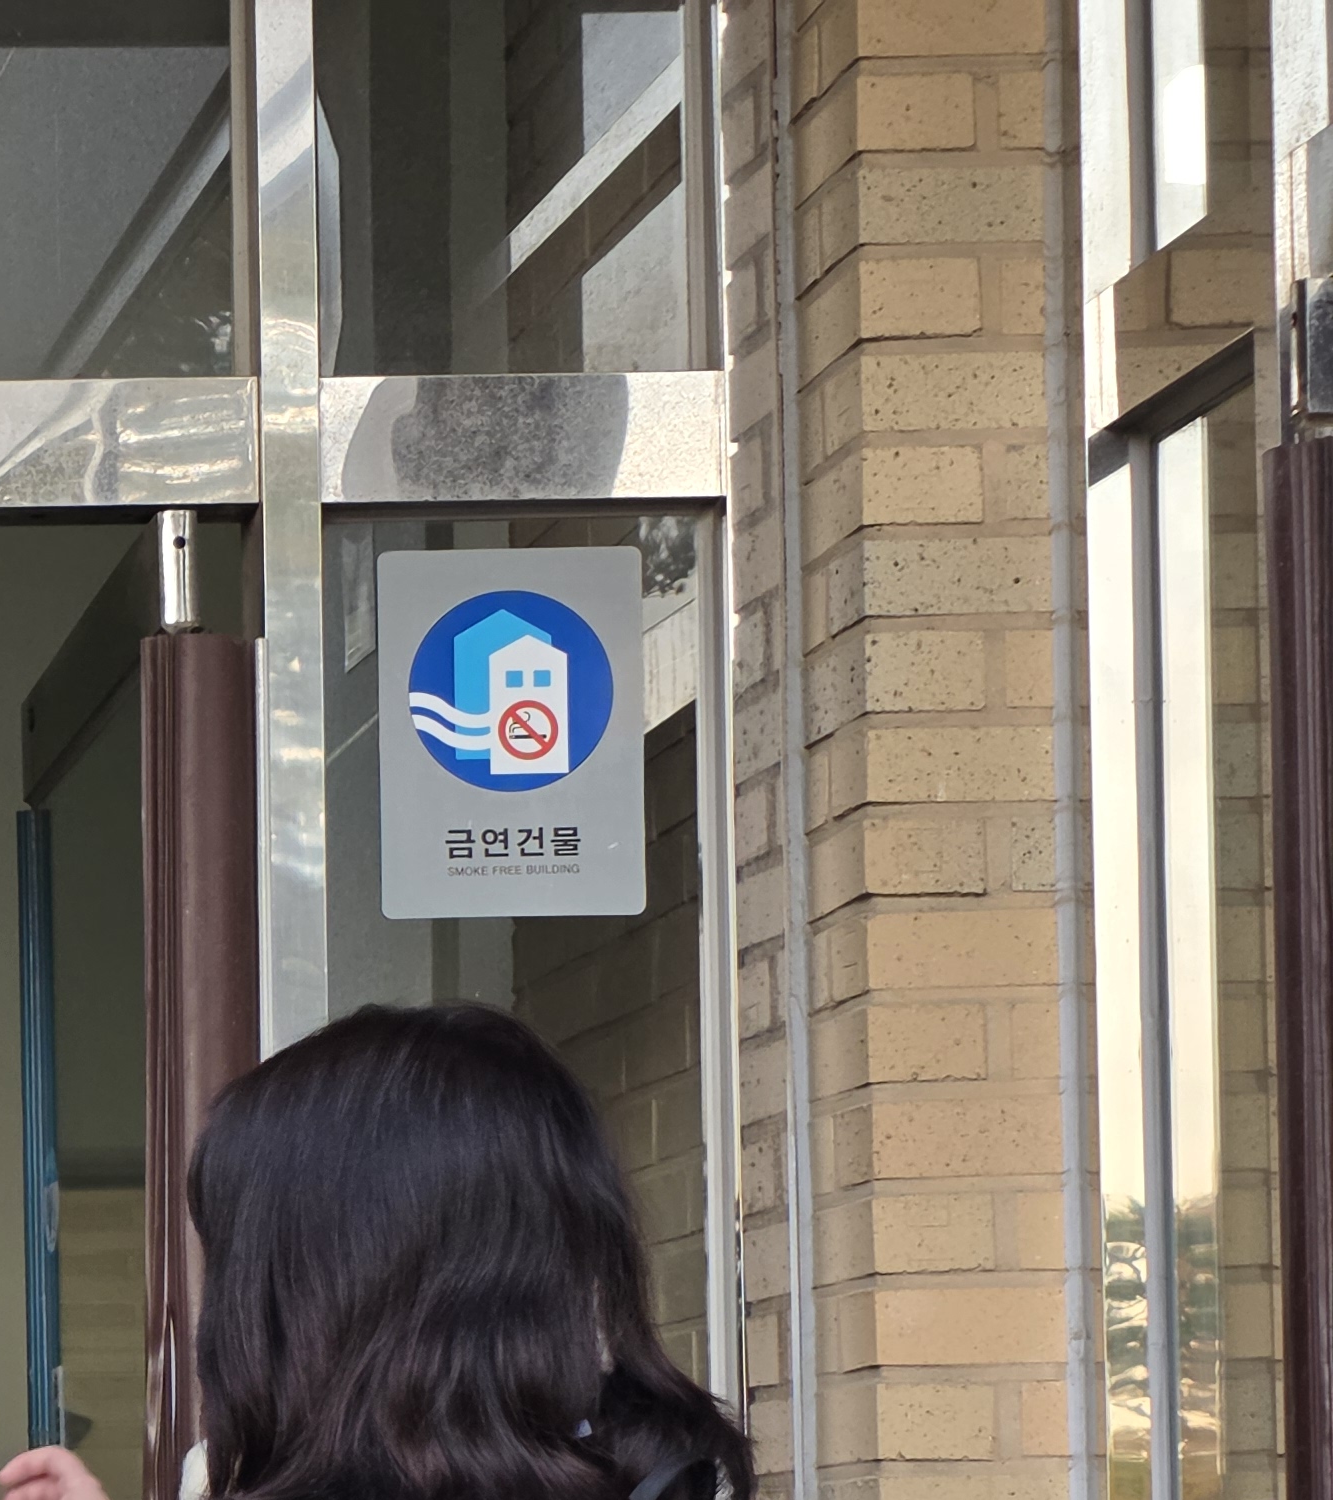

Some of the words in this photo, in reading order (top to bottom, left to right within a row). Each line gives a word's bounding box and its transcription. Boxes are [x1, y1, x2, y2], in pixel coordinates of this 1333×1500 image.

[444, 826, 582, 860] 금연건물
[447, 864, 489, 876] SMOKE
[492, 863, 523, 875] FREE
[526, 863, 581, 875] BUILDING
